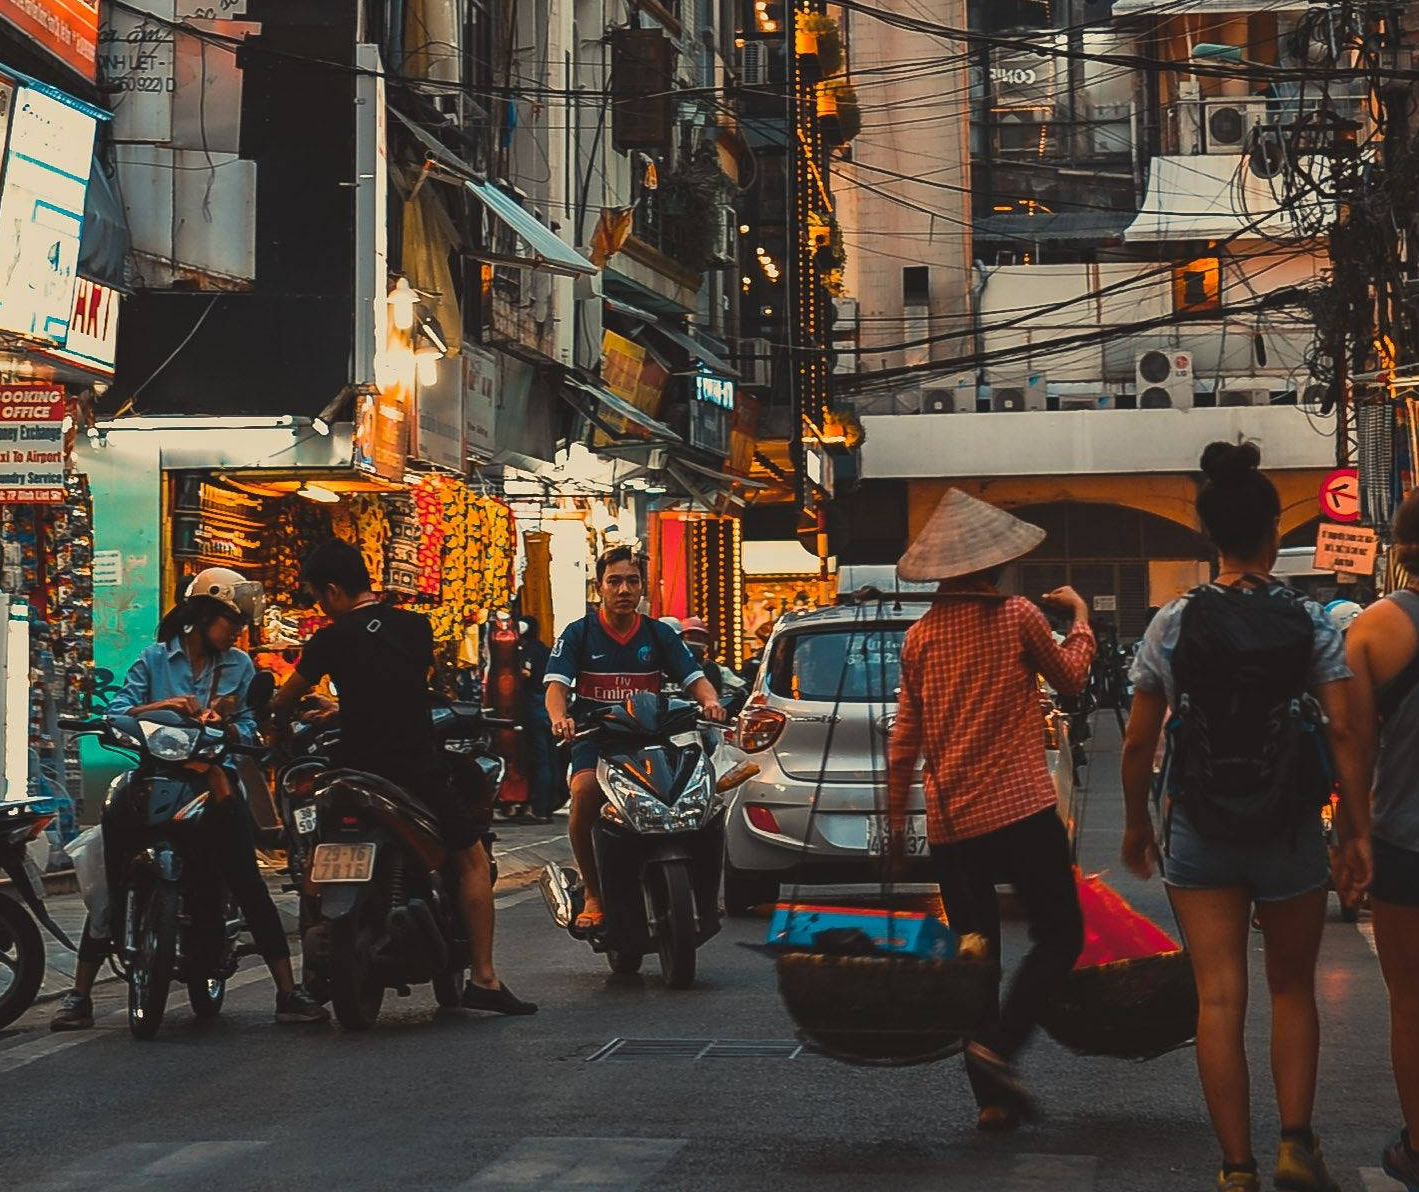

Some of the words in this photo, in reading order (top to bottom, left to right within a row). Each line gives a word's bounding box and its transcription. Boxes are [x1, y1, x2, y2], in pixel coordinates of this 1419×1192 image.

[2, 406, 51, 418] OFFICE
[12, 450, 24, 462] To
[26, 449, 62, 463] Airport
[27, 472, 63, 484] Service
[615, 676, 631, 687] Fly
